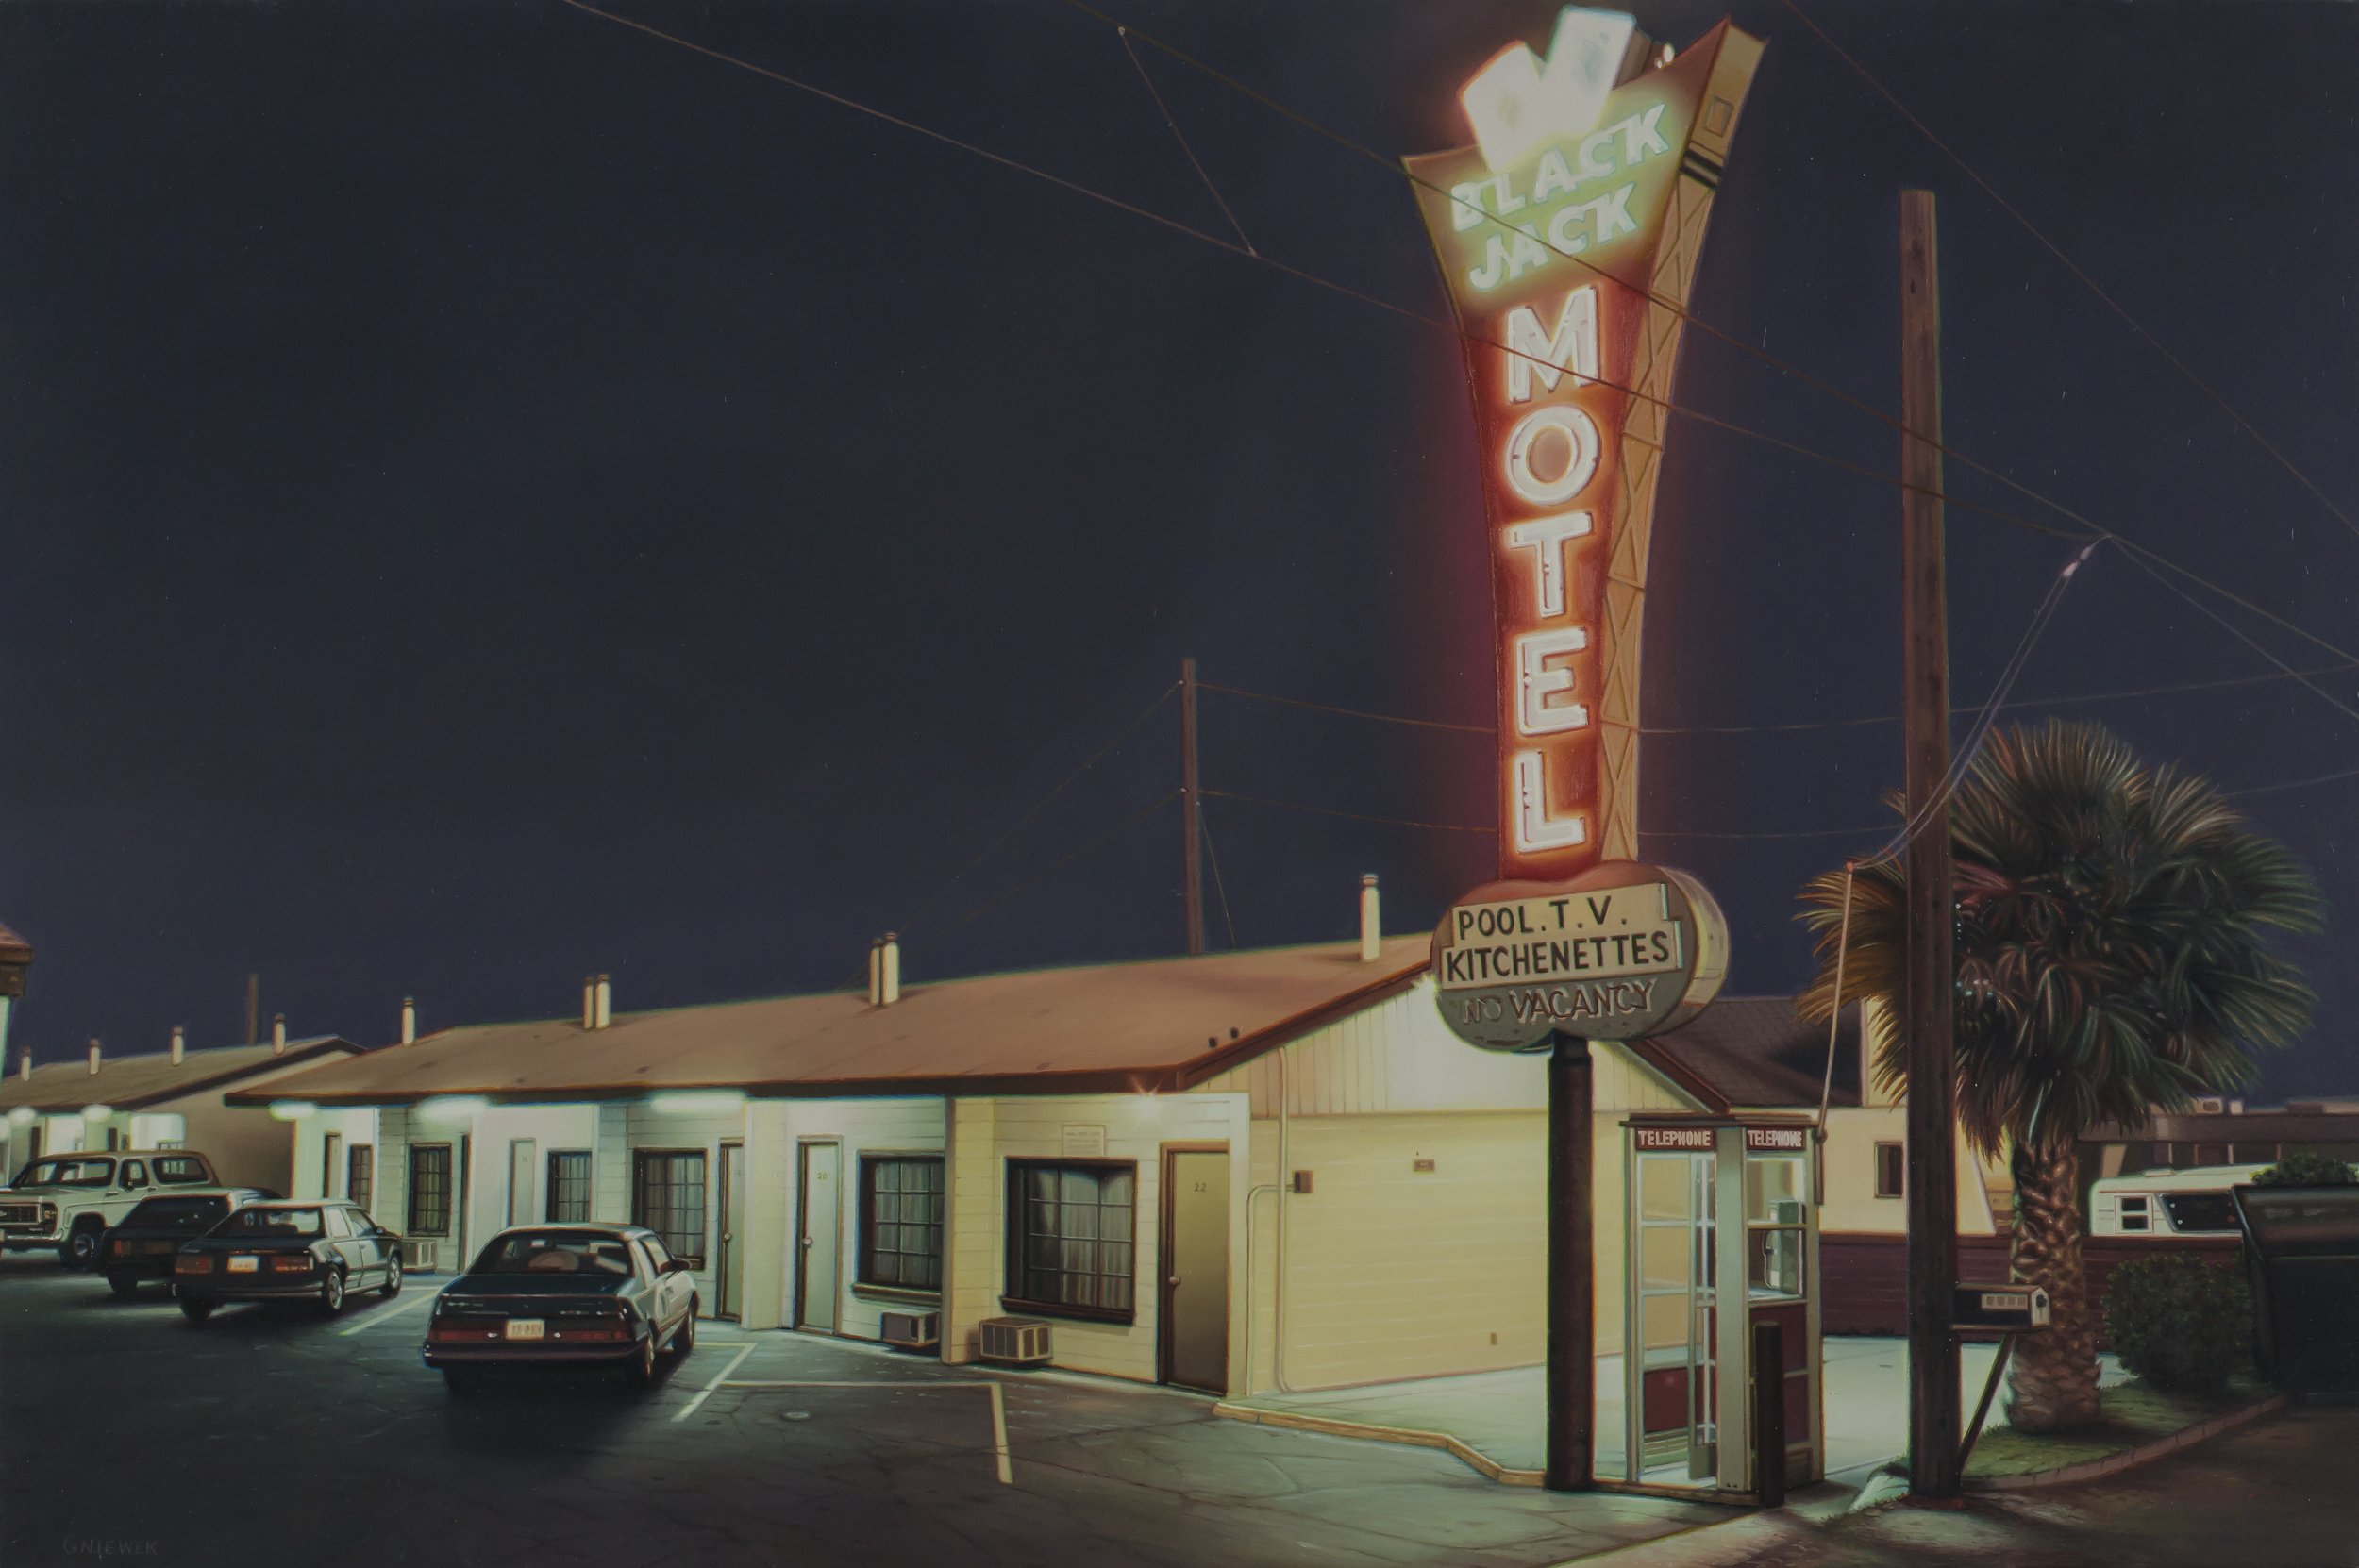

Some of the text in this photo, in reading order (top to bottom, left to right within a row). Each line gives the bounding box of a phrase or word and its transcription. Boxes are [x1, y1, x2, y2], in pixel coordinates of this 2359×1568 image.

[1450, 104, 1669, 232] BLACK
[1469, 182, 1637, 290] JACK
[1503, 285, 1600, 853] MOTEL
[1446, 930, 1670, 983] KITCHENETTES
[1463, 977, 1658, 1025] NO VACANCY
[1637, 1130, 1712, 1147] TELEPHONE
[1747, 1129, 1803, 1147] TELEPHONE
[1194, 1181, 1207, 1193] 22
[62, 1533, 159, 1556] GNIEWEK
